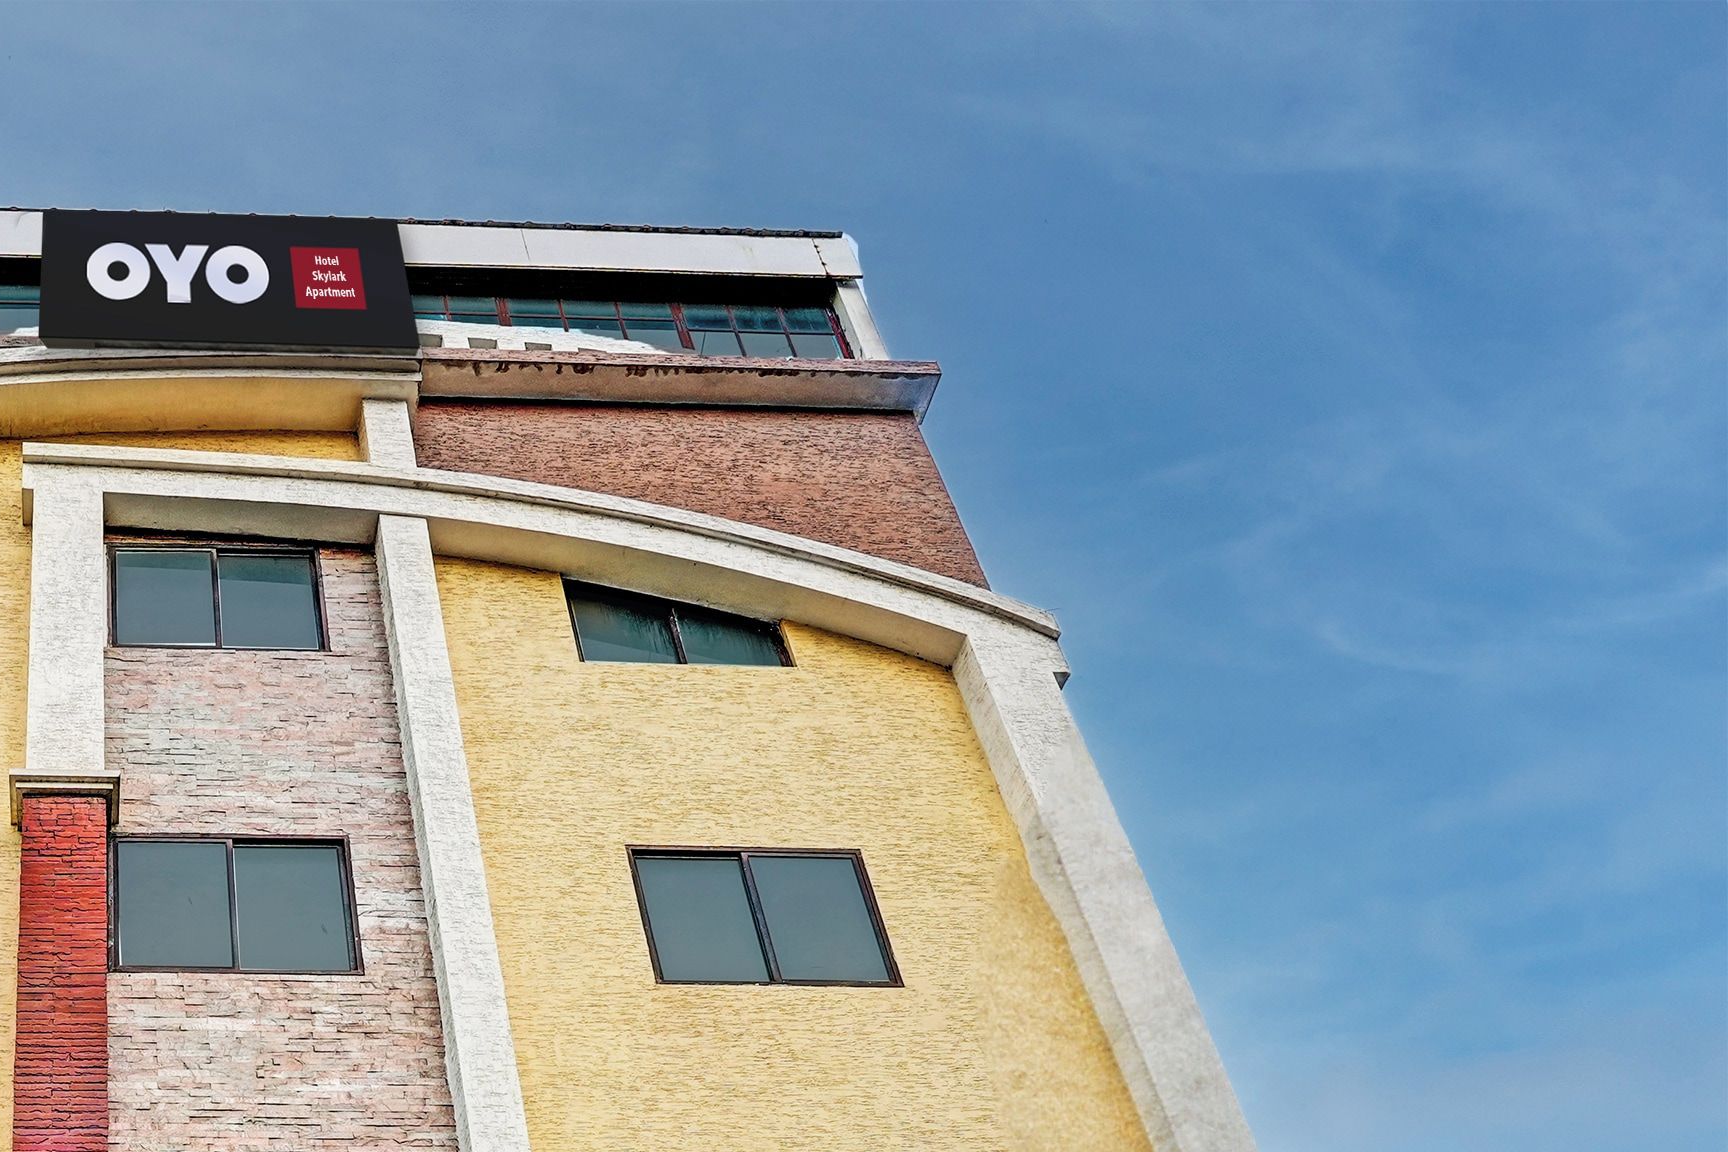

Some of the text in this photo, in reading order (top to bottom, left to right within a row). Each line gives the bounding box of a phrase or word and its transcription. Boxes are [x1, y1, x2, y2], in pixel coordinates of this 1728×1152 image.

[314, 255, 340, 266] Hotel
[86, 242, 270, 304] OYO
[312, 269, 347, 283] Skylark
[305, 286, 356, 300] Apartment
